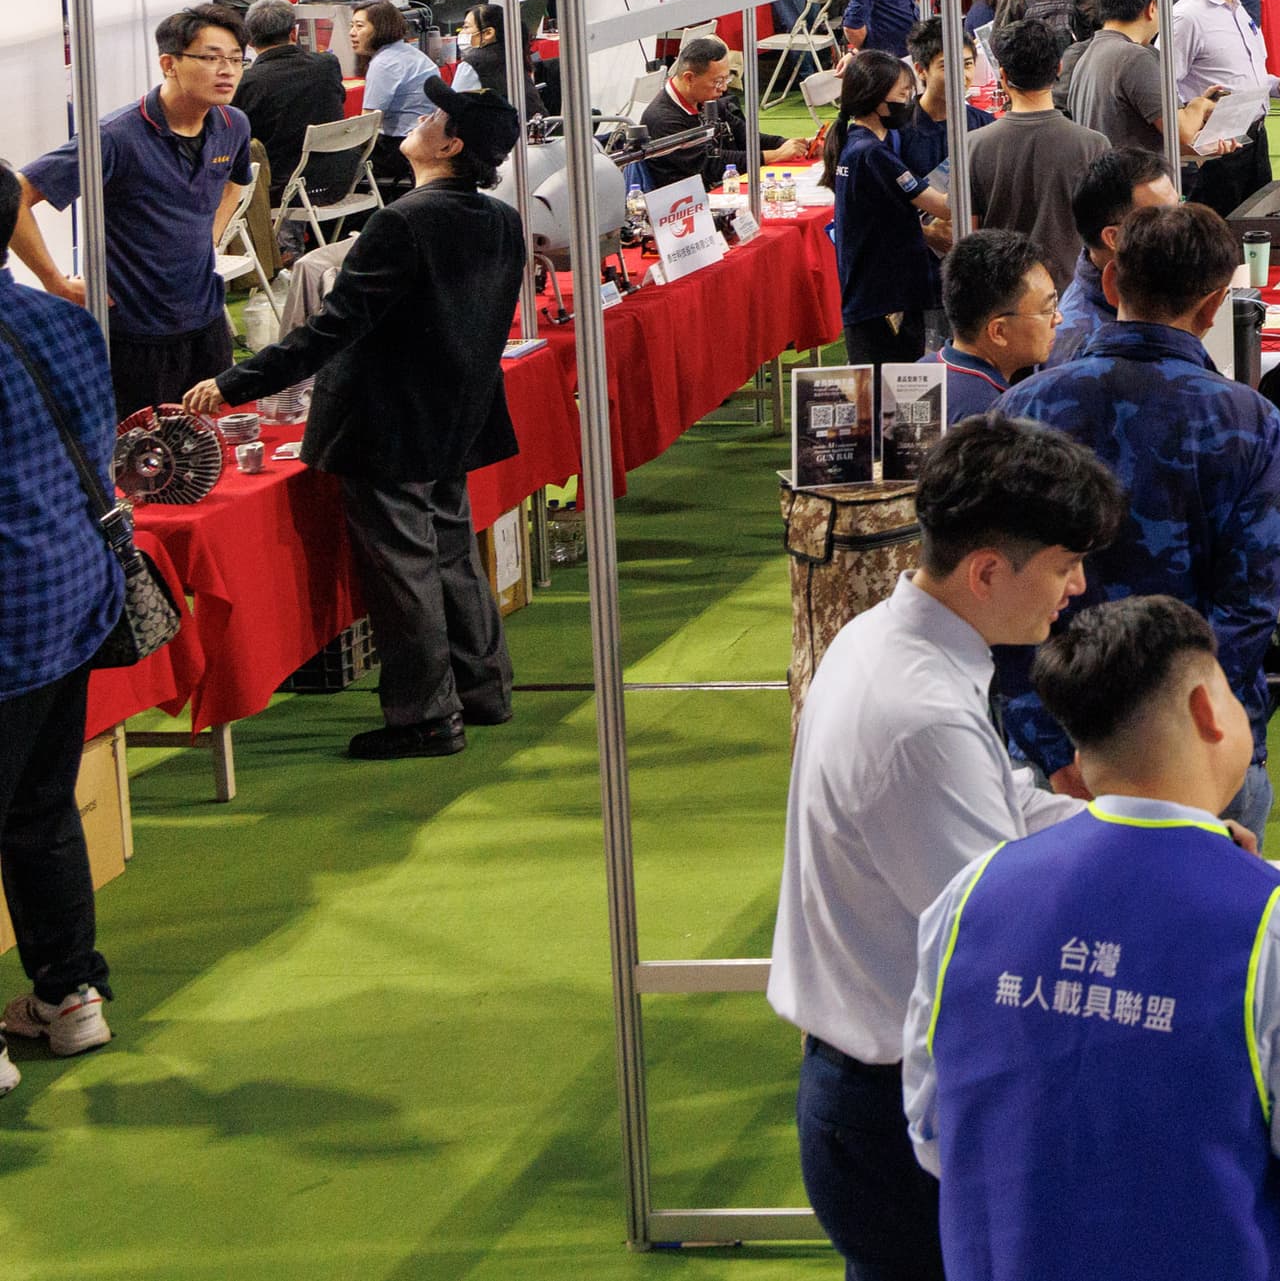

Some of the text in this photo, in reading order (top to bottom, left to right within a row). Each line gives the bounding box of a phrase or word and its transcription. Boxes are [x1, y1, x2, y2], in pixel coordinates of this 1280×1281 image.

[659, 202, 704, 227] POWER
[1059, 936, 1122, 978] 台灣
[994, 971, 1177, 1033] 無人載具聯盟
